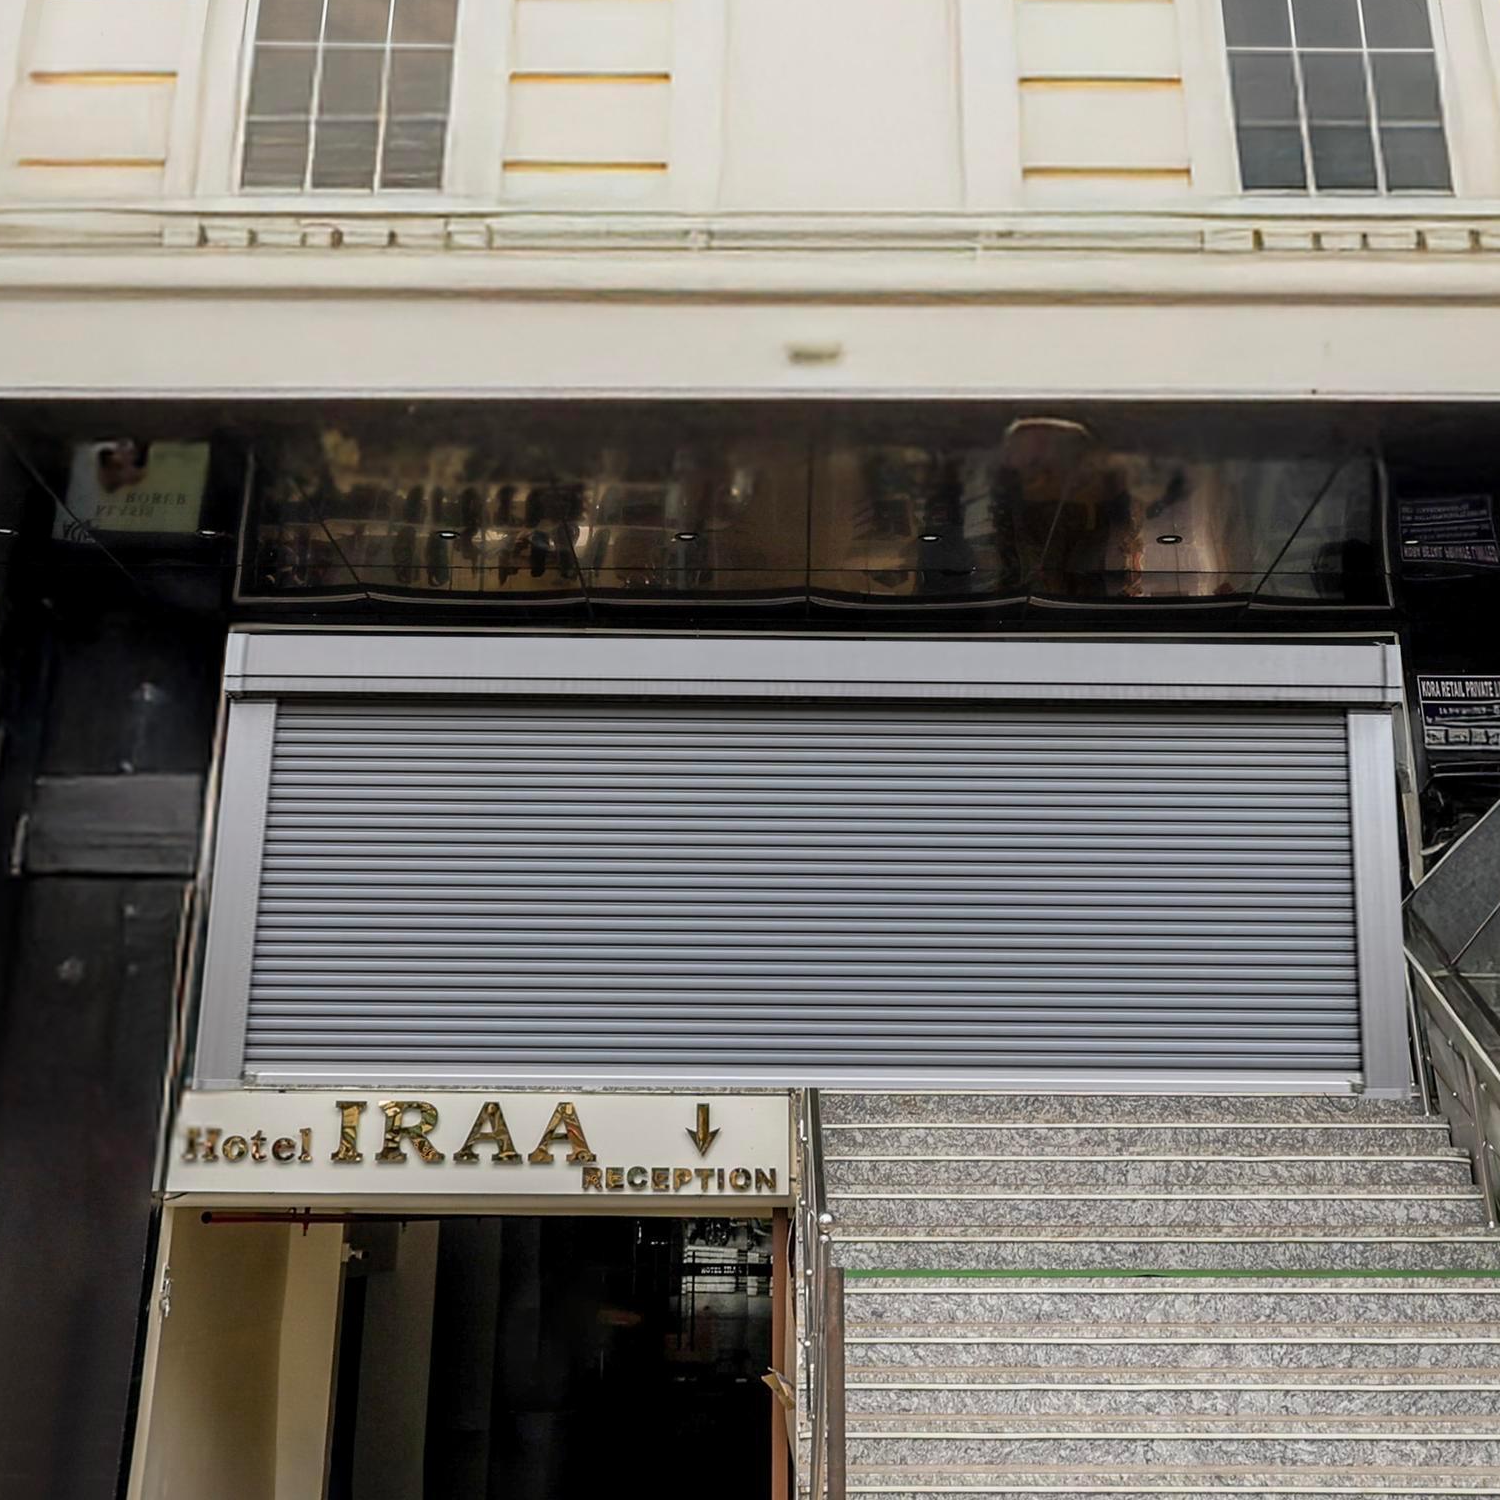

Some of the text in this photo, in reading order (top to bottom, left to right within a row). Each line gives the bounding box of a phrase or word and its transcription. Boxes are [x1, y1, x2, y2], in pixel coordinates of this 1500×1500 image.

[181, 1100, 597, 1165] Hotel IRAA
[581, 1166, 778, 1192] RECEPTION
